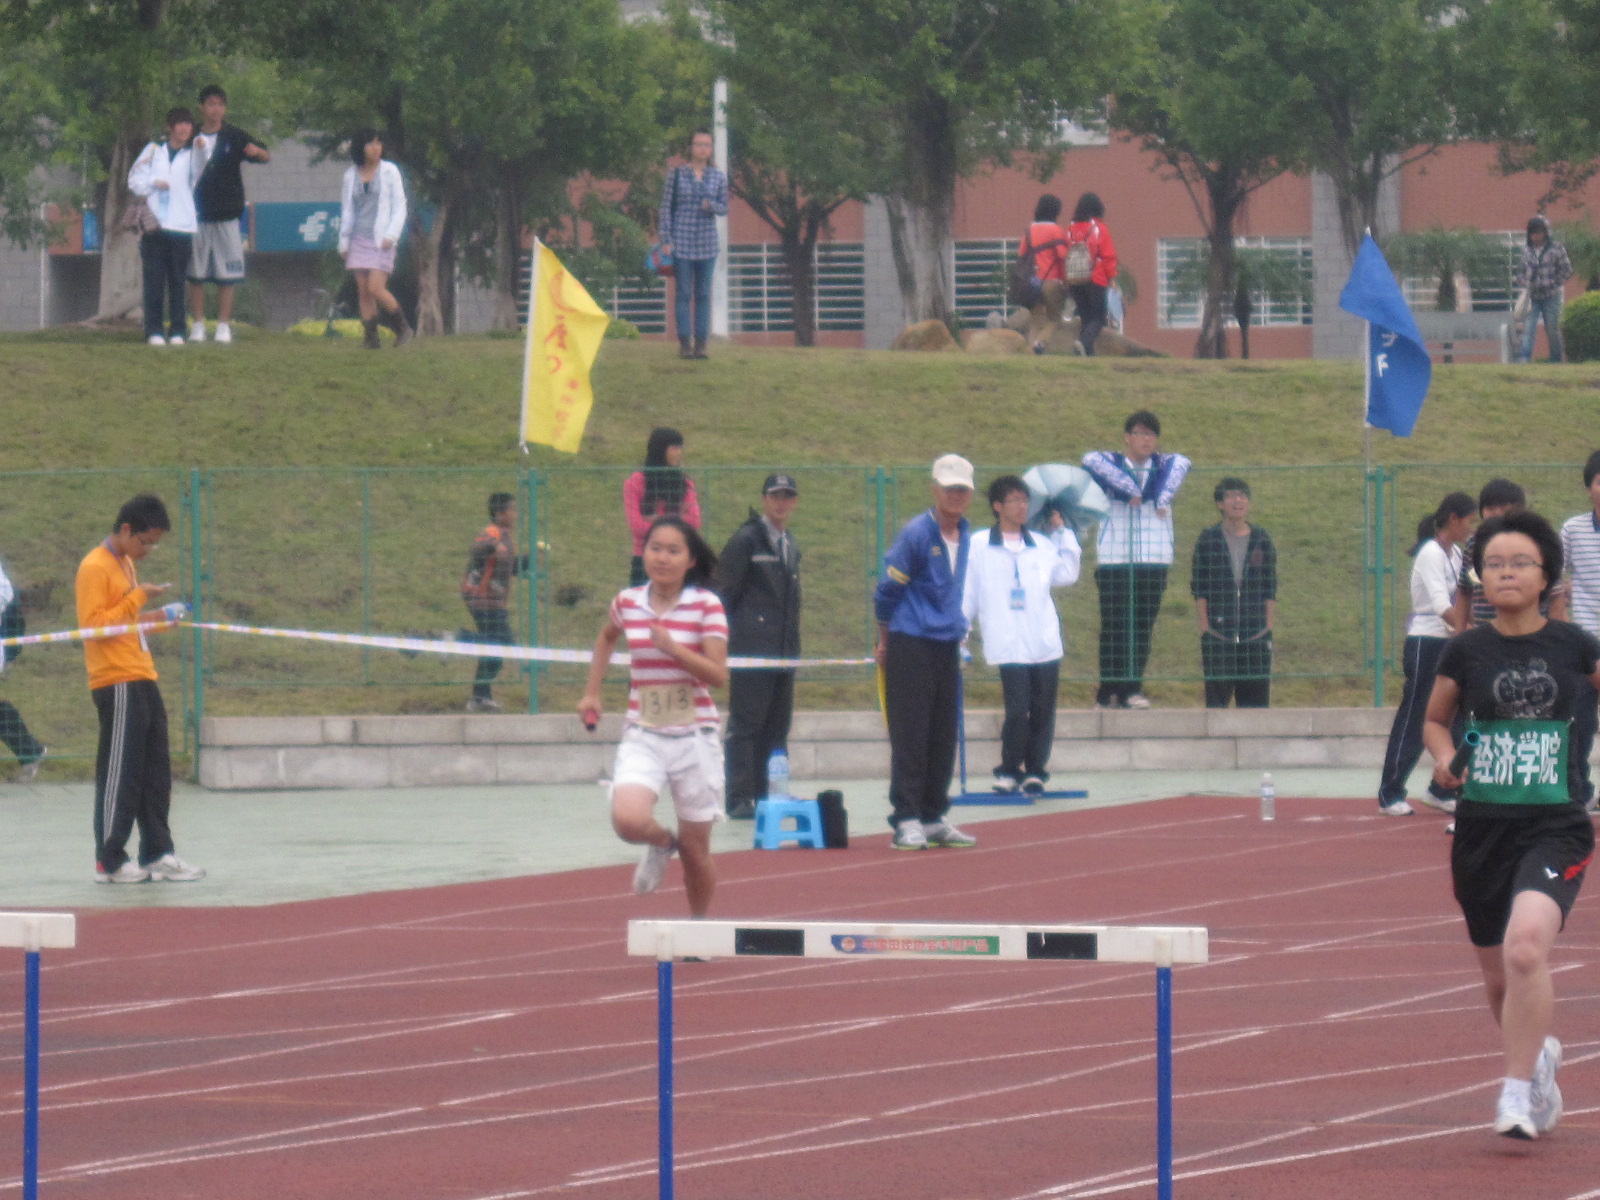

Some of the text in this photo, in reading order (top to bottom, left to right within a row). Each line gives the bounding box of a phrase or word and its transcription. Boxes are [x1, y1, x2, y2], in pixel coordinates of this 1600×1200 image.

[641, 687, 690, 715] 1313
[1472, 730, 1562, 786] 经济学院
